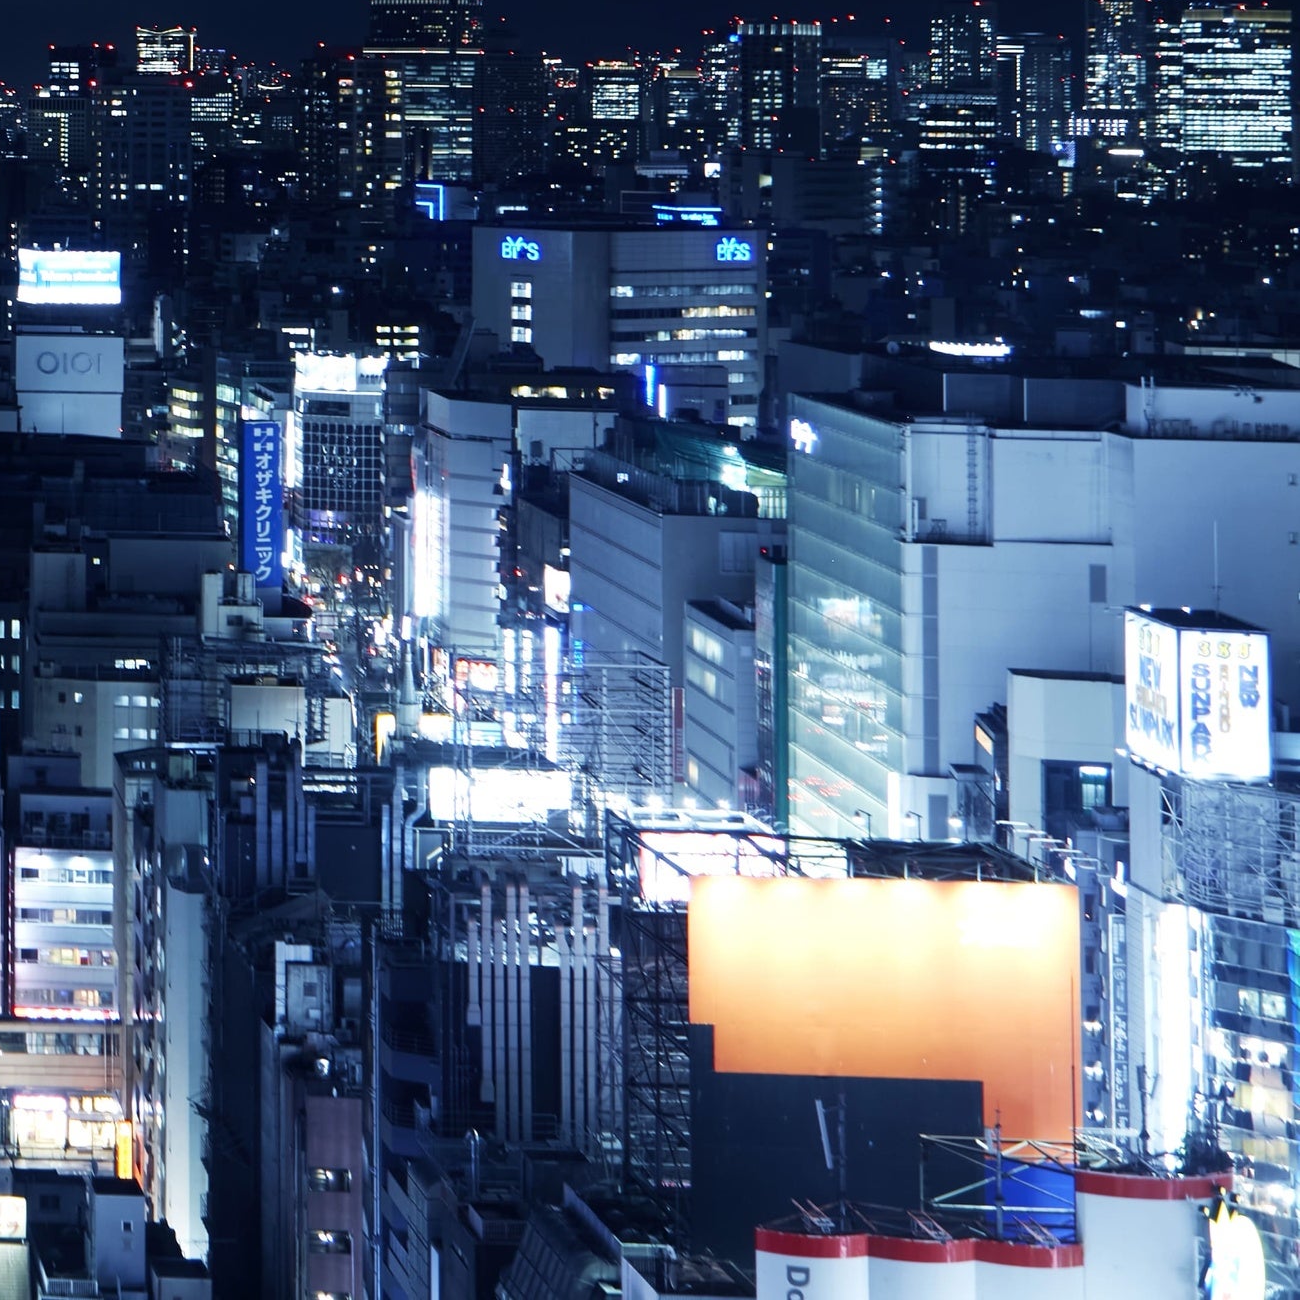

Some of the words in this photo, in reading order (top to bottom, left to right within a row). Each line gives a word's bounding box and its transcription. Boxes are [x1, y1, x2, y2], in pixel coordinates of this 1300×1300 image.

[255, 453, 274, 581] オザキクリニック
